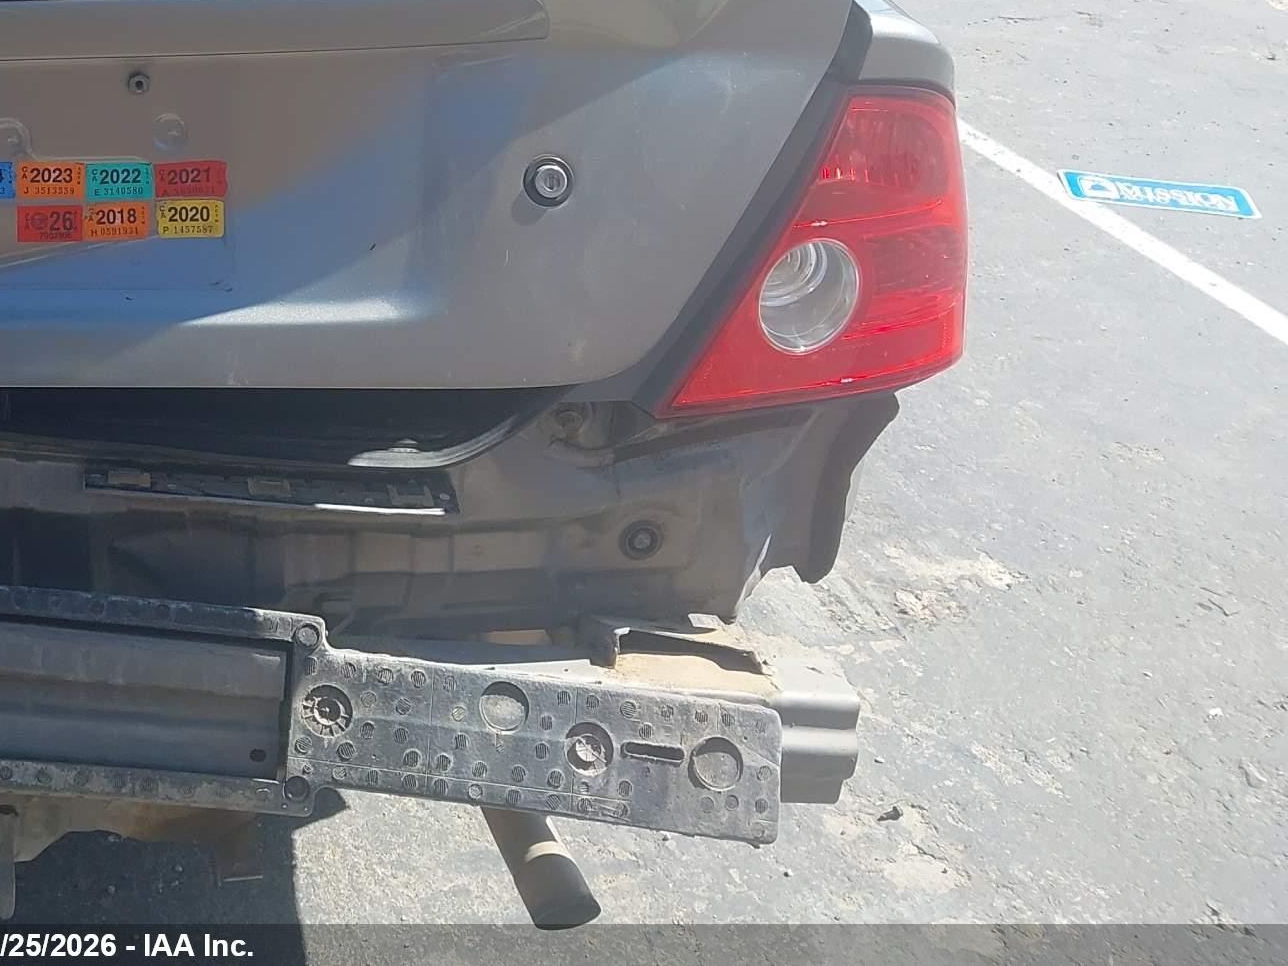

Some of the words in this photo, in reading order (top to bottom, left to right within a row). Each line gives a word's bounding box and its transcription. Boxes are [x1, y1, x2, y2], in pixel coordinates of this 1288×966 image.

[30, 167, 72, 183] 2023
[99, 169, 141, 185] 2022
[168, 167, 211, 185] 2021
[96, 208, 137, 225] 2018
[168, 206, 210, 222] 2020
